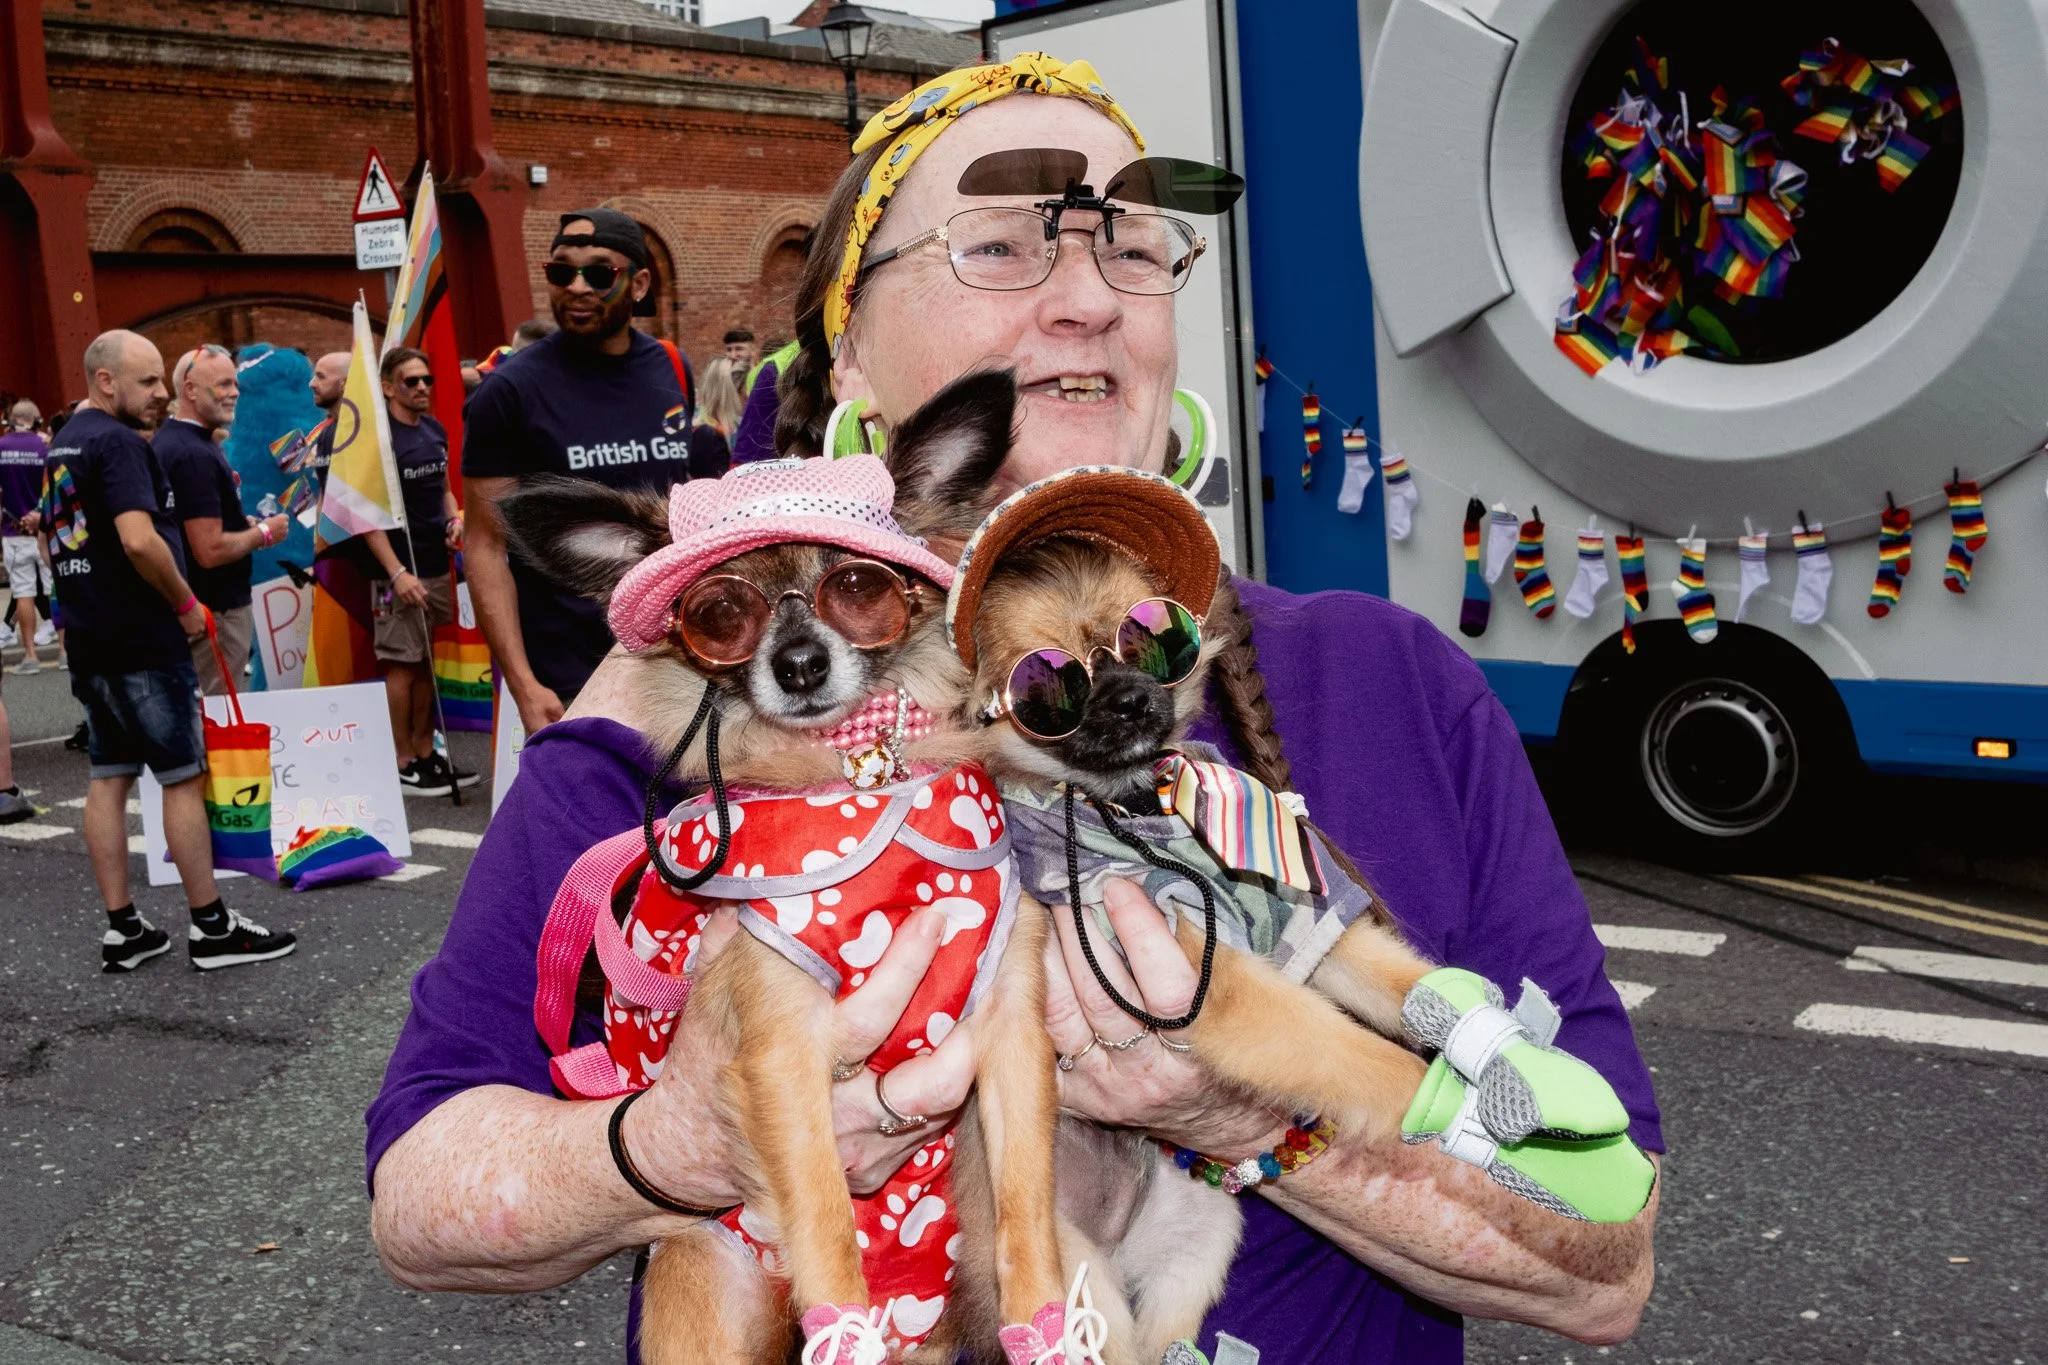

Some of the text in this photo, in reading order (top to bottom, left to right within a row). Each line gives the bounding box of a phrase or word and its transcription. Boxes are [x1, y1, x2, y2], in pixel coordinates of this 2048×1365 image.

[361, 223, 400, 236] Humped
[368, 239, 395, 250] Zebra
[363, 252, 403, 265] Crossing
[567, 436, 689, 470] British Gas
[56, 559, 92, 577] YERS
[271, 764, 300, 789] TE
[218, 809, 253, 828] Gas
[271, 796, 376, 826] BRATE
